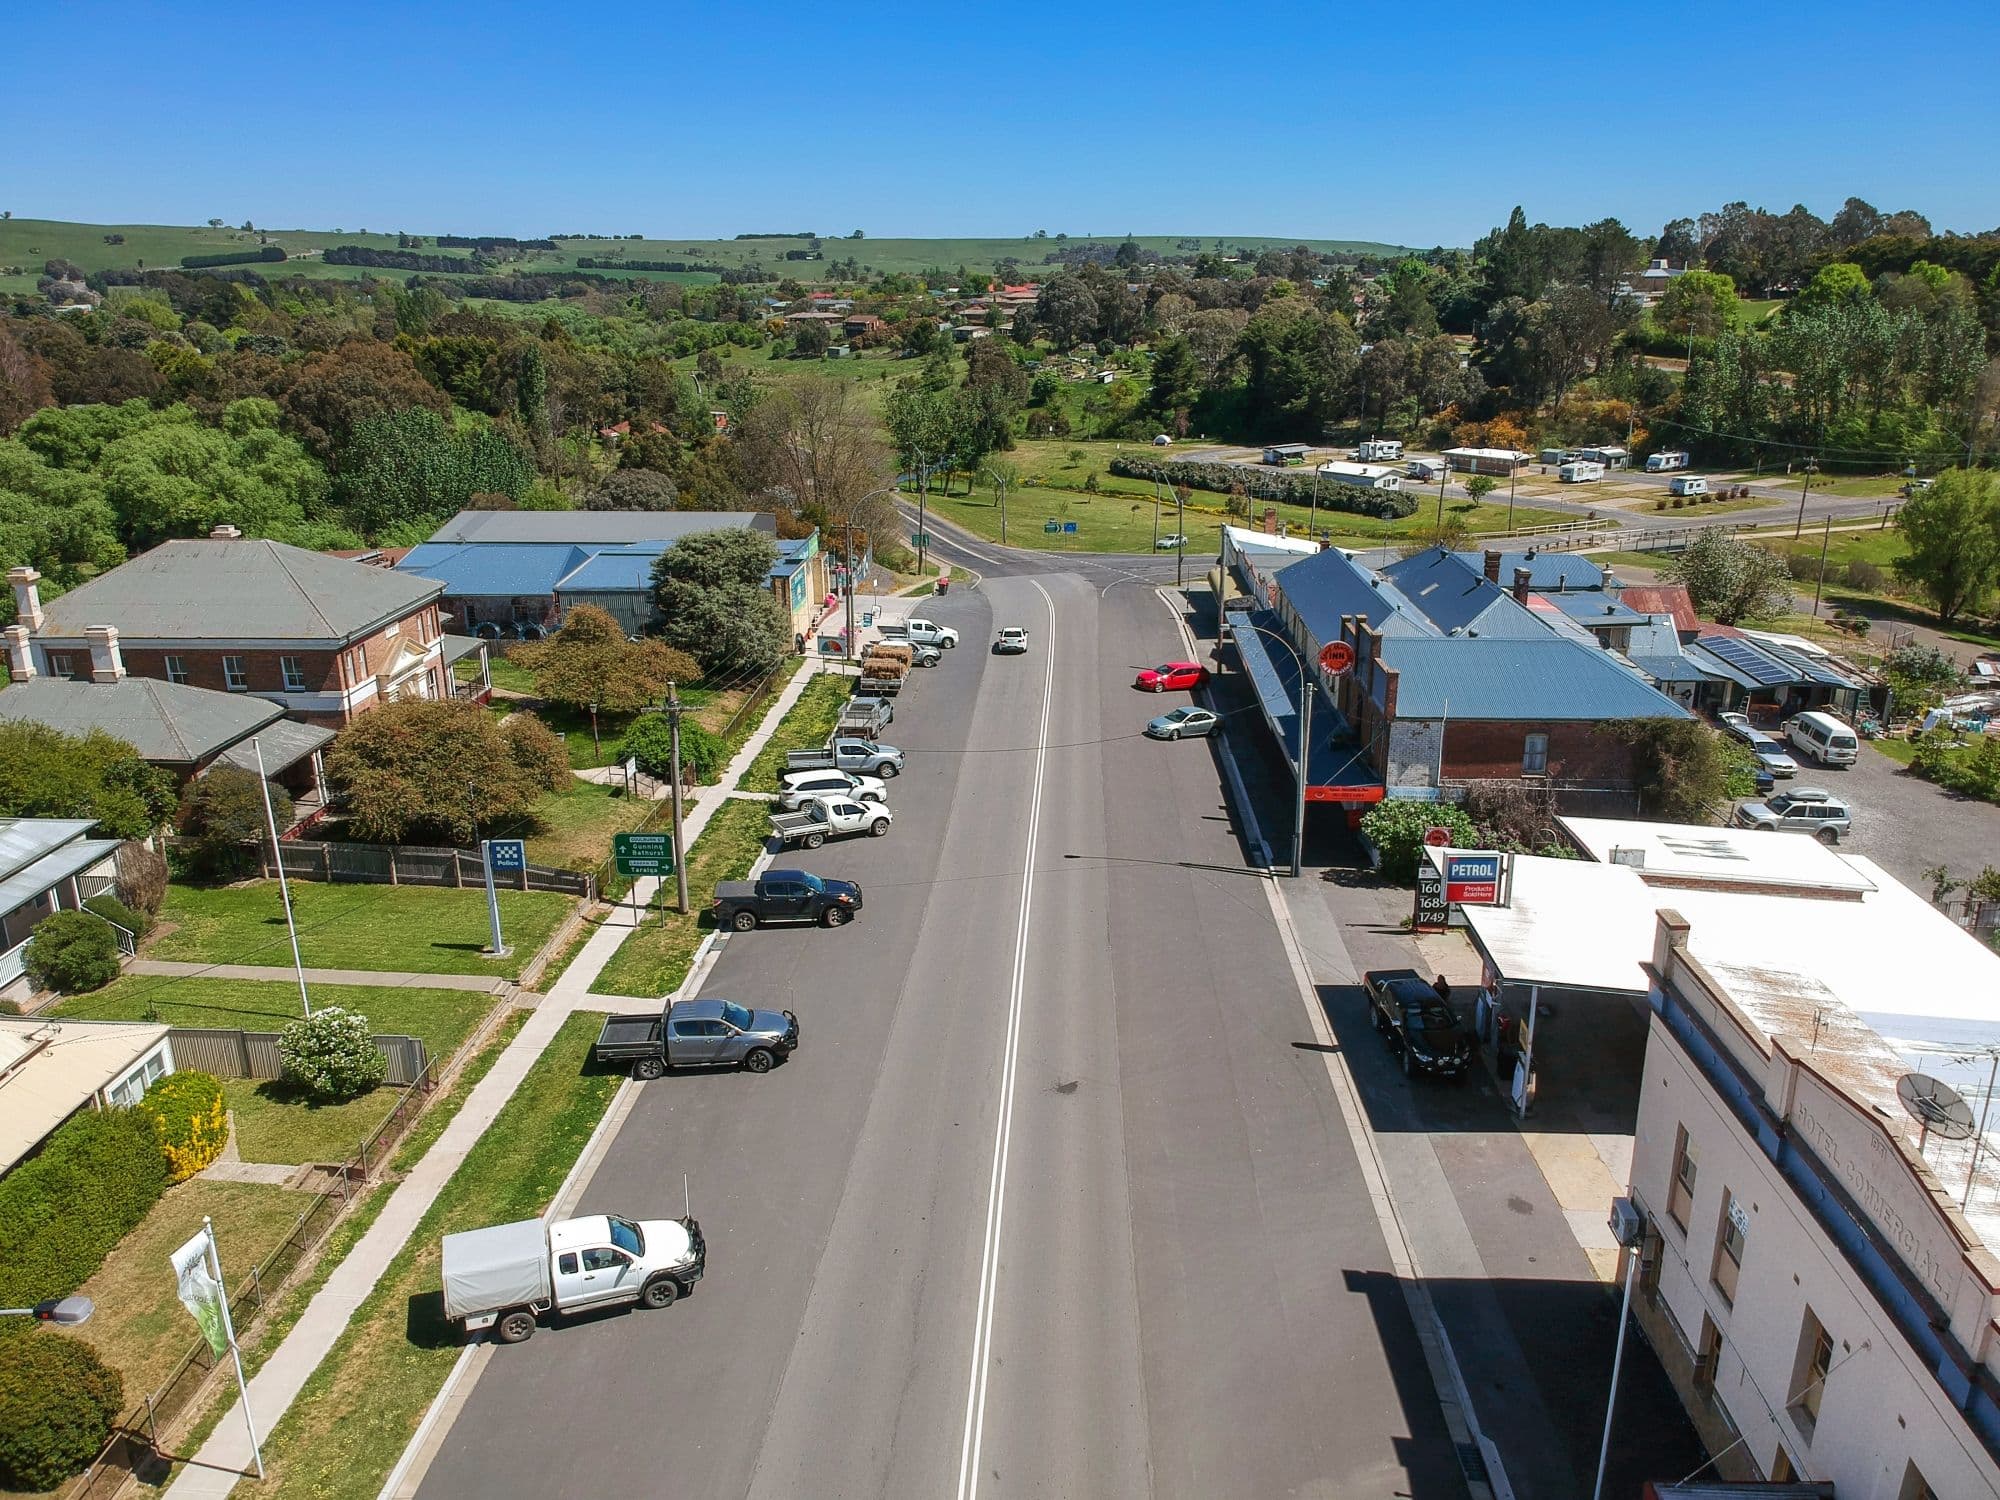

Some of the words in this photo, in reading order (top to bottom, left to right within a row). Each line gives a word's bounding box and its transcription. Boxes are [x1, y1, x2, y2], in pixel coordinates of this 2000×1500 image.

[1452, 864, 1493, 876] PETROL
[1419, 912, 1445, 923] 1749
[1799, 1102, 1840, 1168] HOTEL
